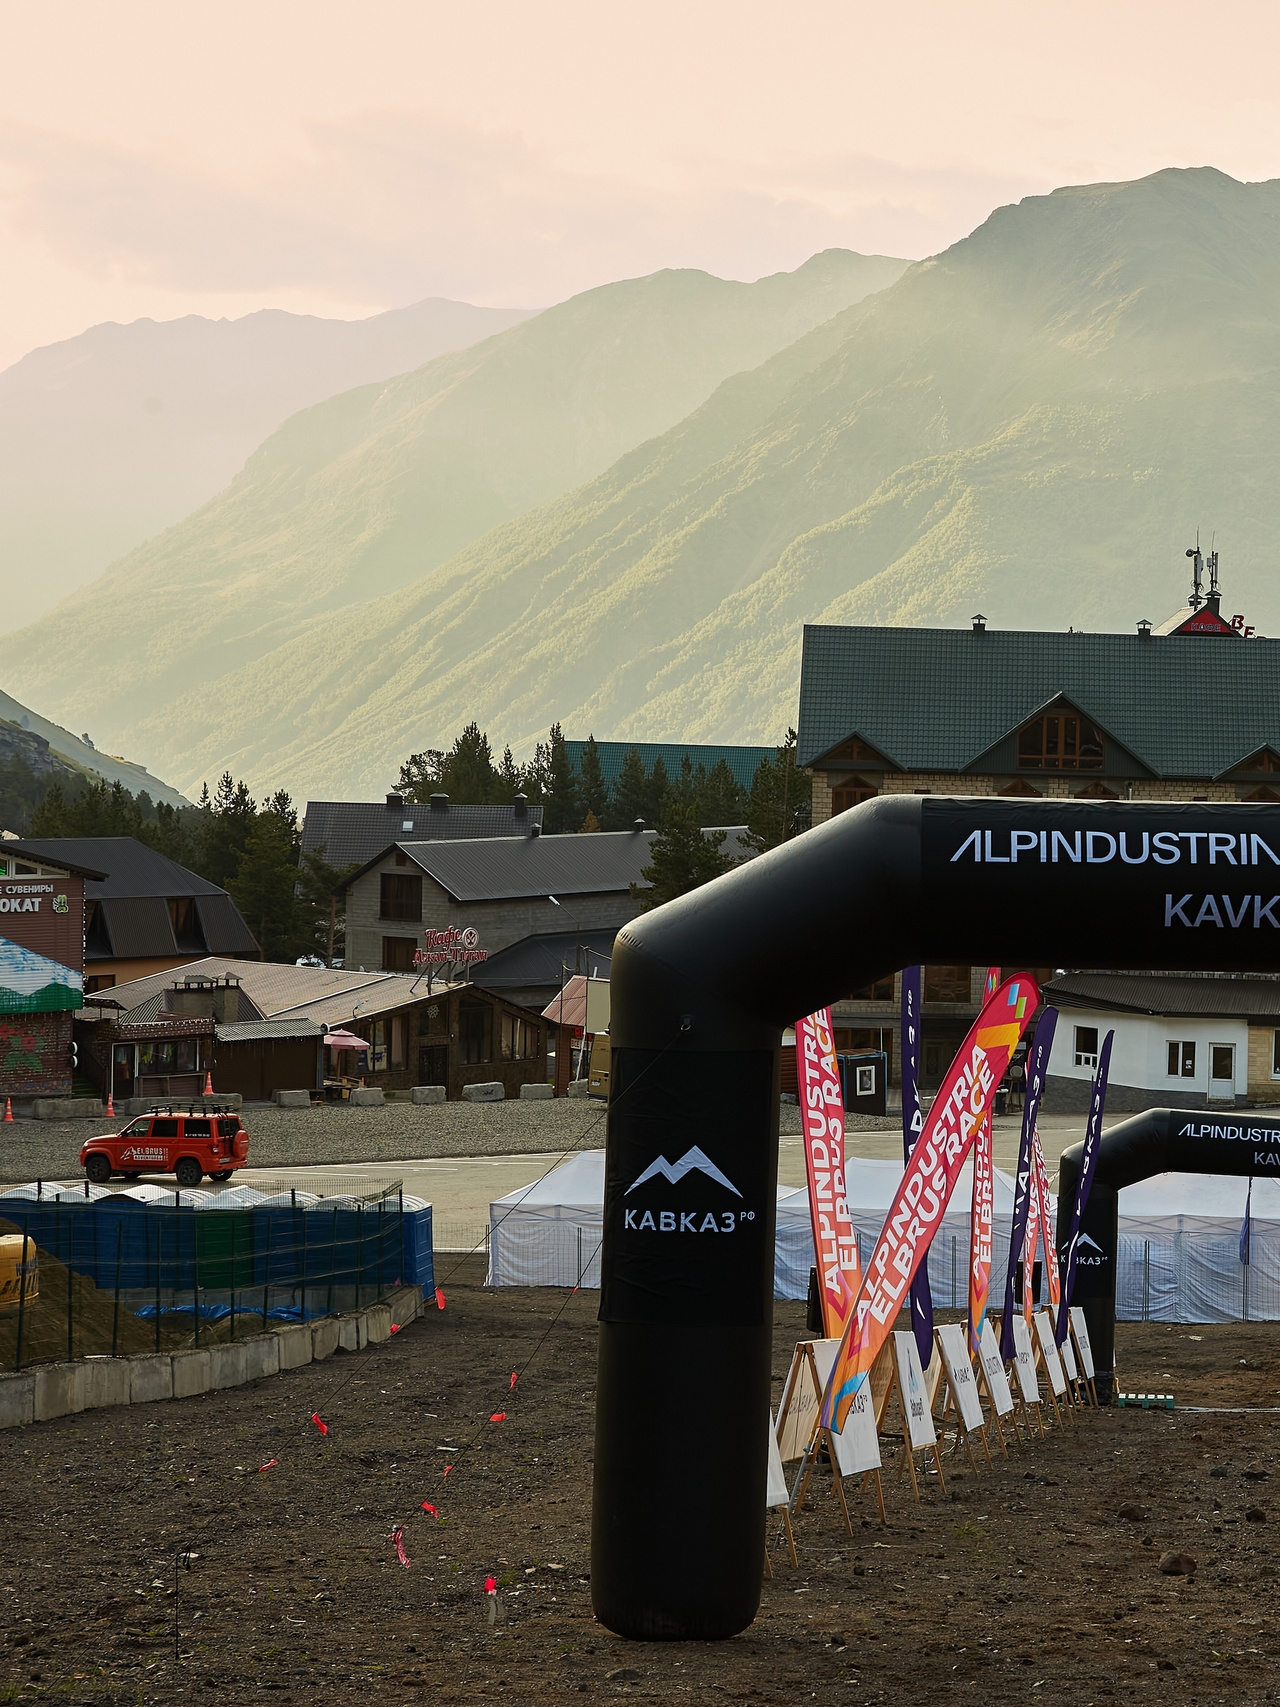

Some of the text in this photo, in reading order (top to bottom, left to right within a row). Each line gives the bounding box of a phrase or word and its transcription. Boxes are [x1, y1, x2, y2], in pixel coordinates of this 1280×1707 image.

[1191, 623, 1222, 632] КАФЕ
[5, 884, 54, 894] СУВЕНИРЫ
[425, 925, 462, 949] Кафе
[136, 1147, 163, 1155] ELBRUS
[856, 1045, 987, 1332] ALPINDUSTRIA
[869, 1059, 995, 1325] ELBRUS RACE
[624, 1208, 756, 1233] КАВКАЗ РФ
